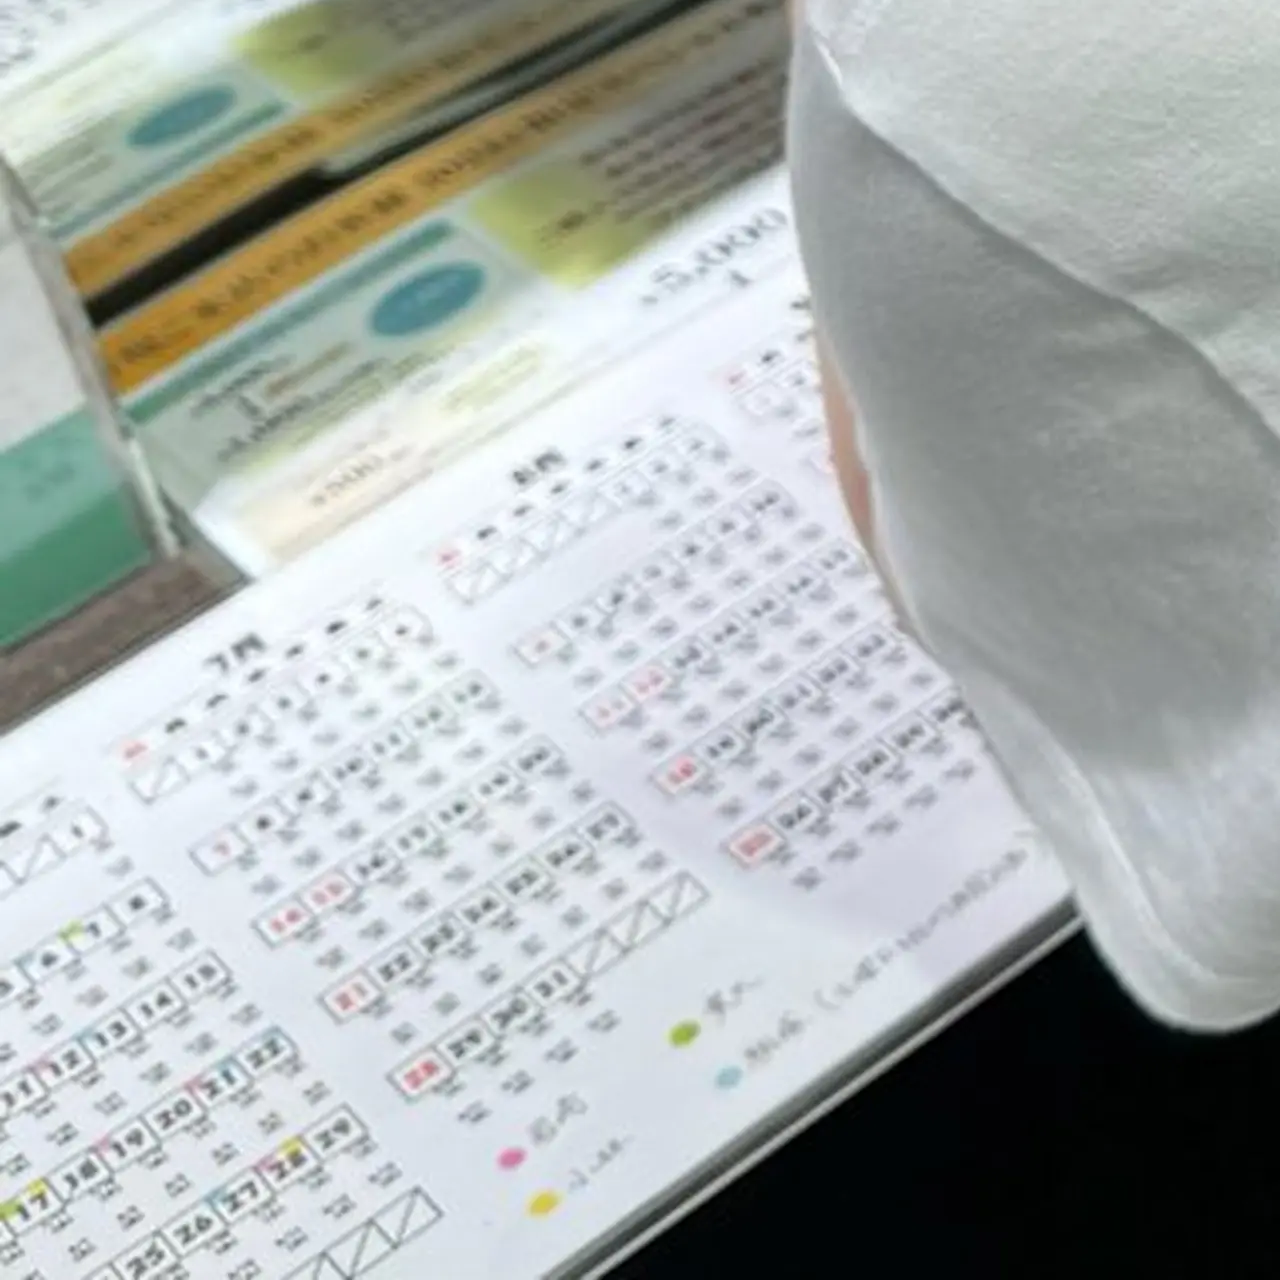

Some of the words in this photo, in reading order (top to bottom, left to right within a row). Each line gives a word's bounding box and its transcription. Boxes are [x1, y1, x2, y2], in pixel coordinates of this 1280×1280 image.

[16, 1192, 49, 1222] 17
[63, 1159, 98, 1190] 18
[110, 1127, 145, 1159] 19
[155, 1099, 192, 1131] 20
[200, 1068, 237, 1099] 21
[246, 1037, 283, 1070] 22
[126, 1242, 165, 1280] 25
[173, 1214, 213, 1245] 26
[222, 1180, 259, 1213] 27
[269, 1148, 308, 1181] 28
[314, 1116, 351, 1150] 29
